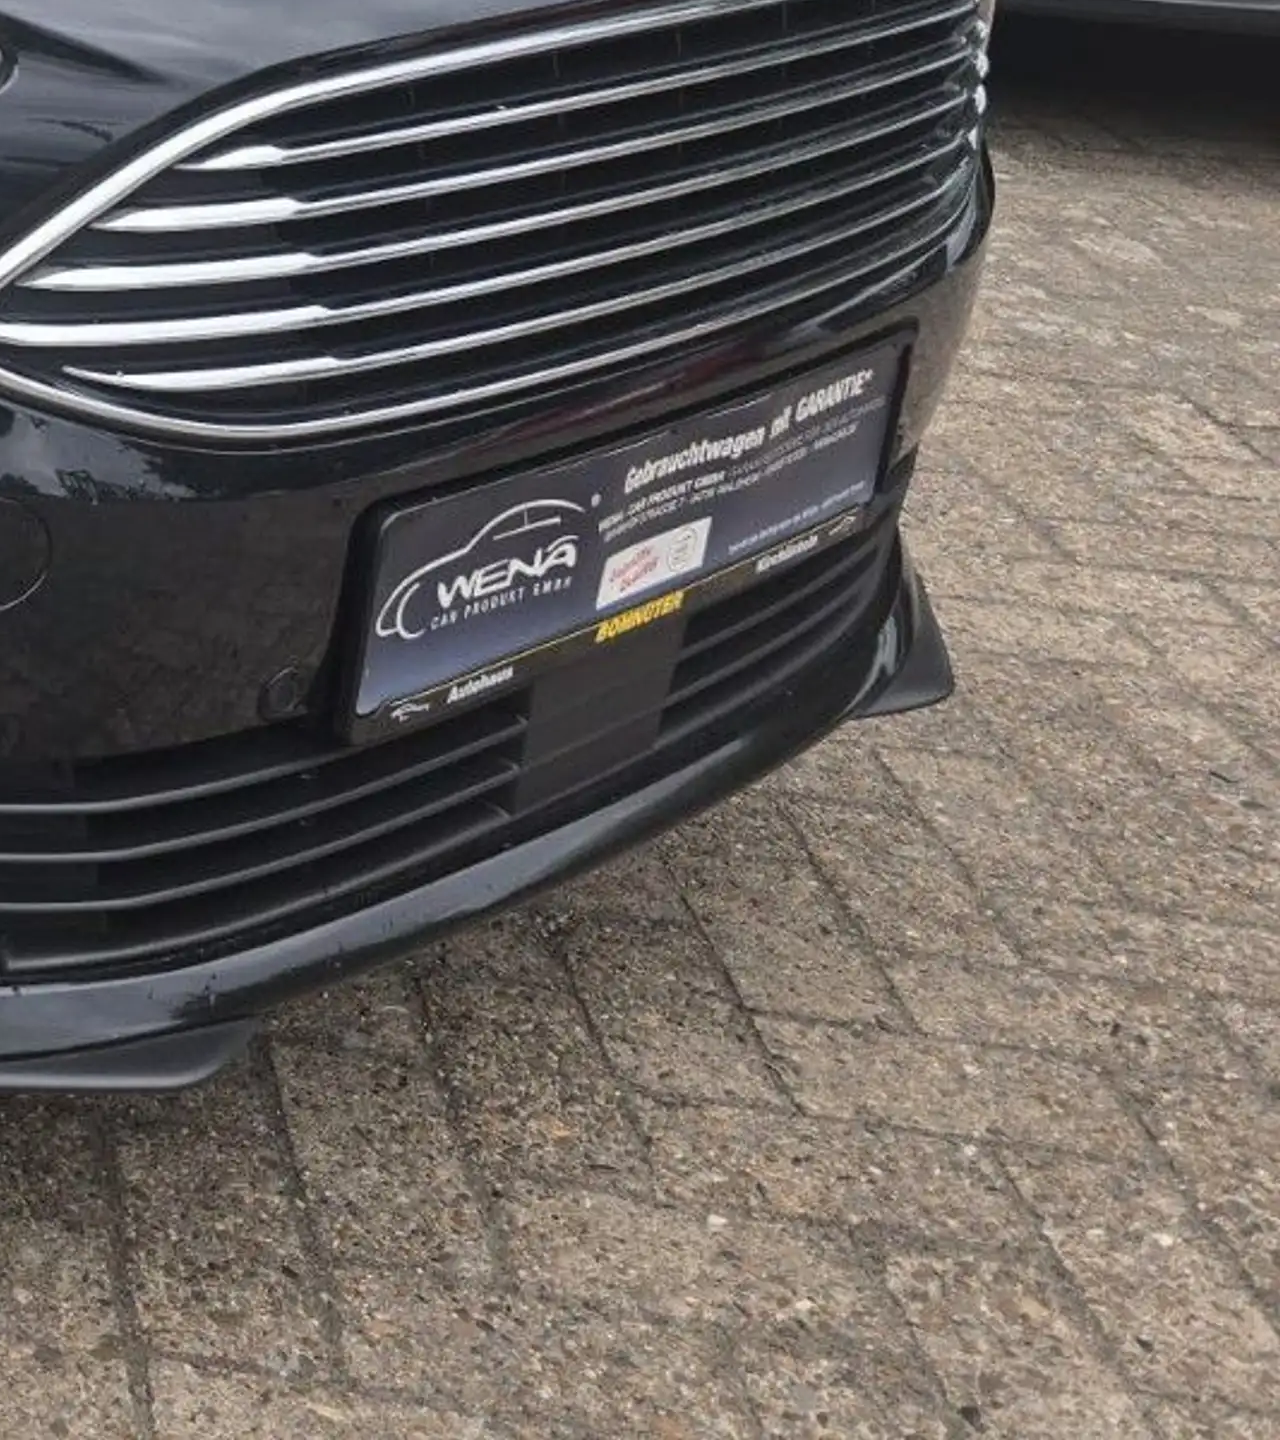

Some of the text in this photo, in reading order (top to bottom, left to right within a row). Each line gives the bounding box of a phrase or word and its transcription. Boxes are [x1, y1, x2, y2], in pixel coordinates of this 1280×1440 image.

[623, 426, 766, 496] Gebrauchtwagen
[437, 536, 578, 609] WENA
[430, 610, 459, 631] CAR
[463, 586, 526, 620] PRODUKT
[446, 665, 515, 705] Autohaus
